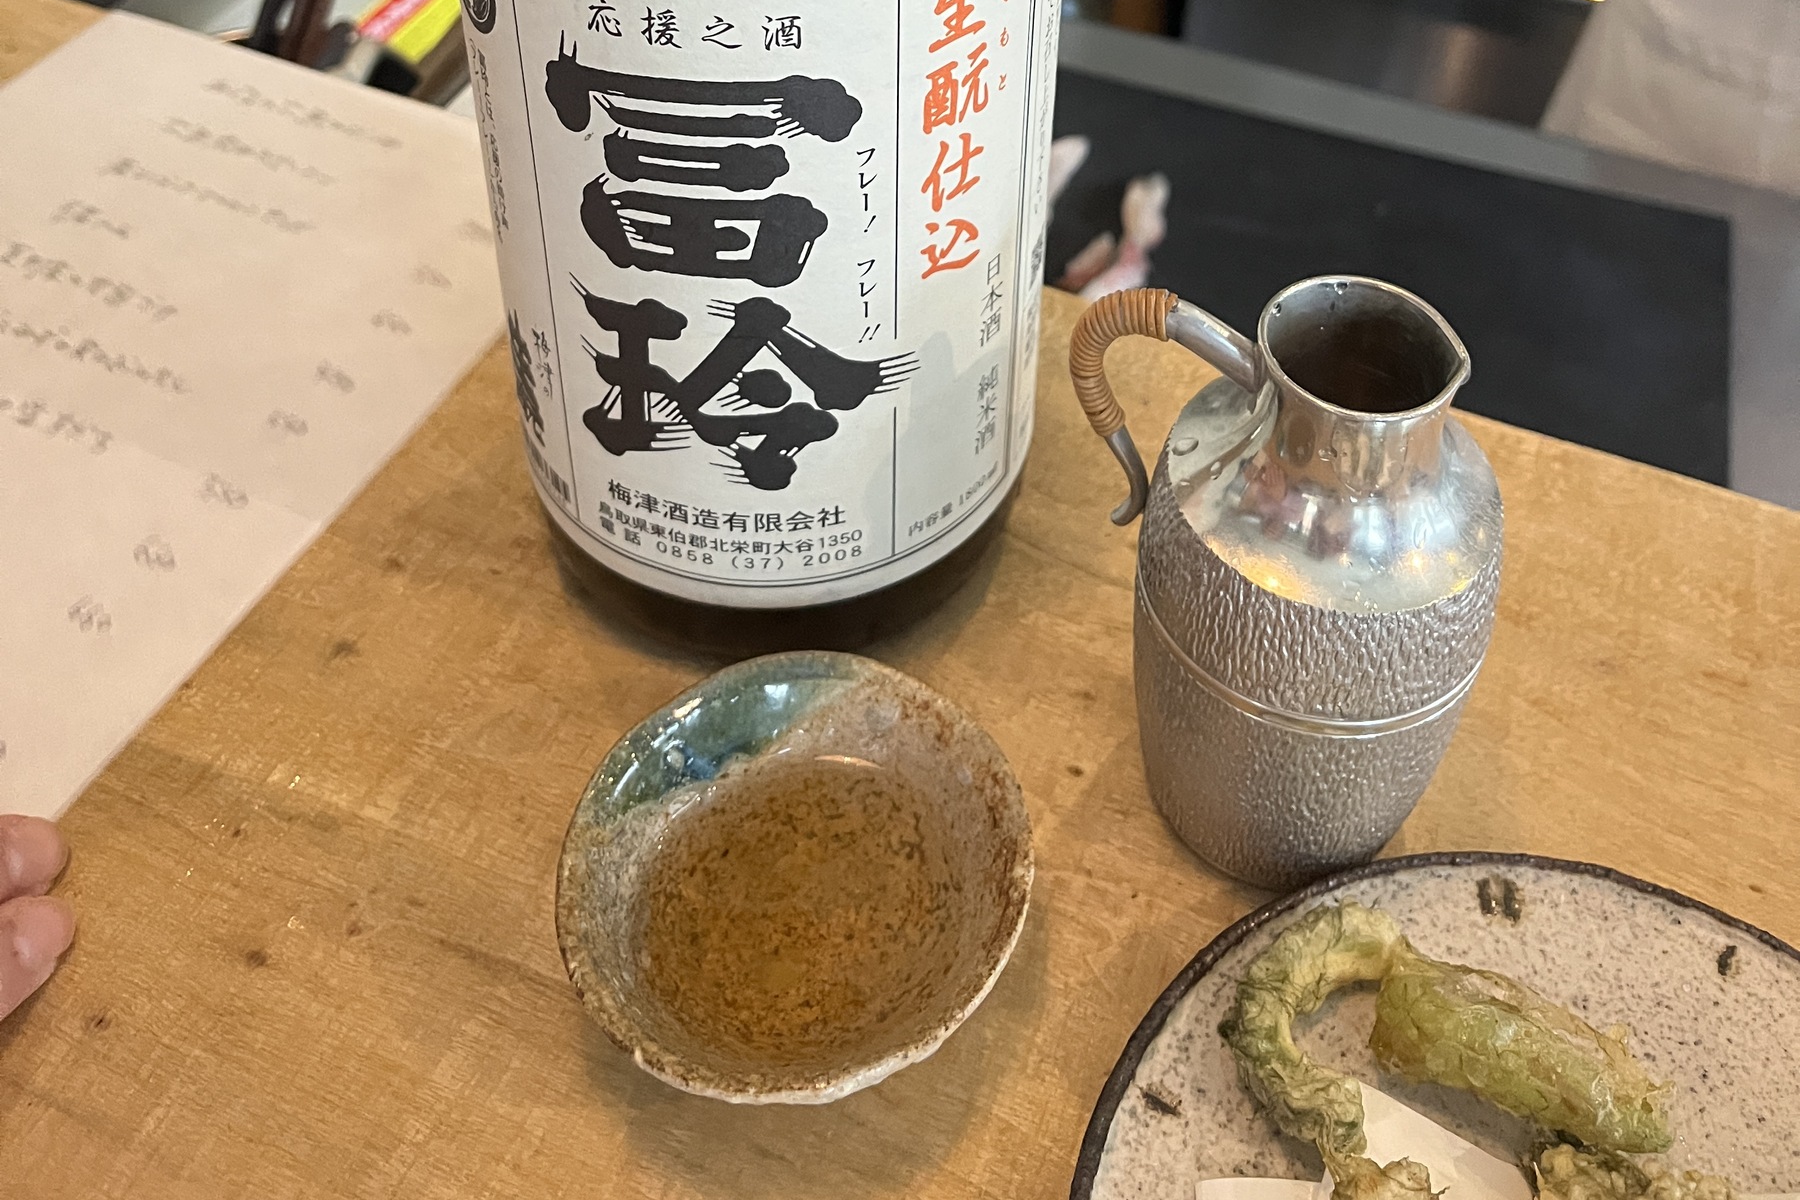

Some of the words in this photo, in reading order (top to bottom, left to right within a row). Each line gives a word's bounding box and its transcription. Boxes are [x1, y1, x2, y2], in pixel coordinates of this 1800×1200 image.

[979, 253, 1004, 347] 日本酒
[973, 362, 999, 455] 純米酒
[608, 478, 847, 533] 梅津酒造有限会社
[655, 540, 715, 566] 0858
[802, 544, 863, 567] 2008
